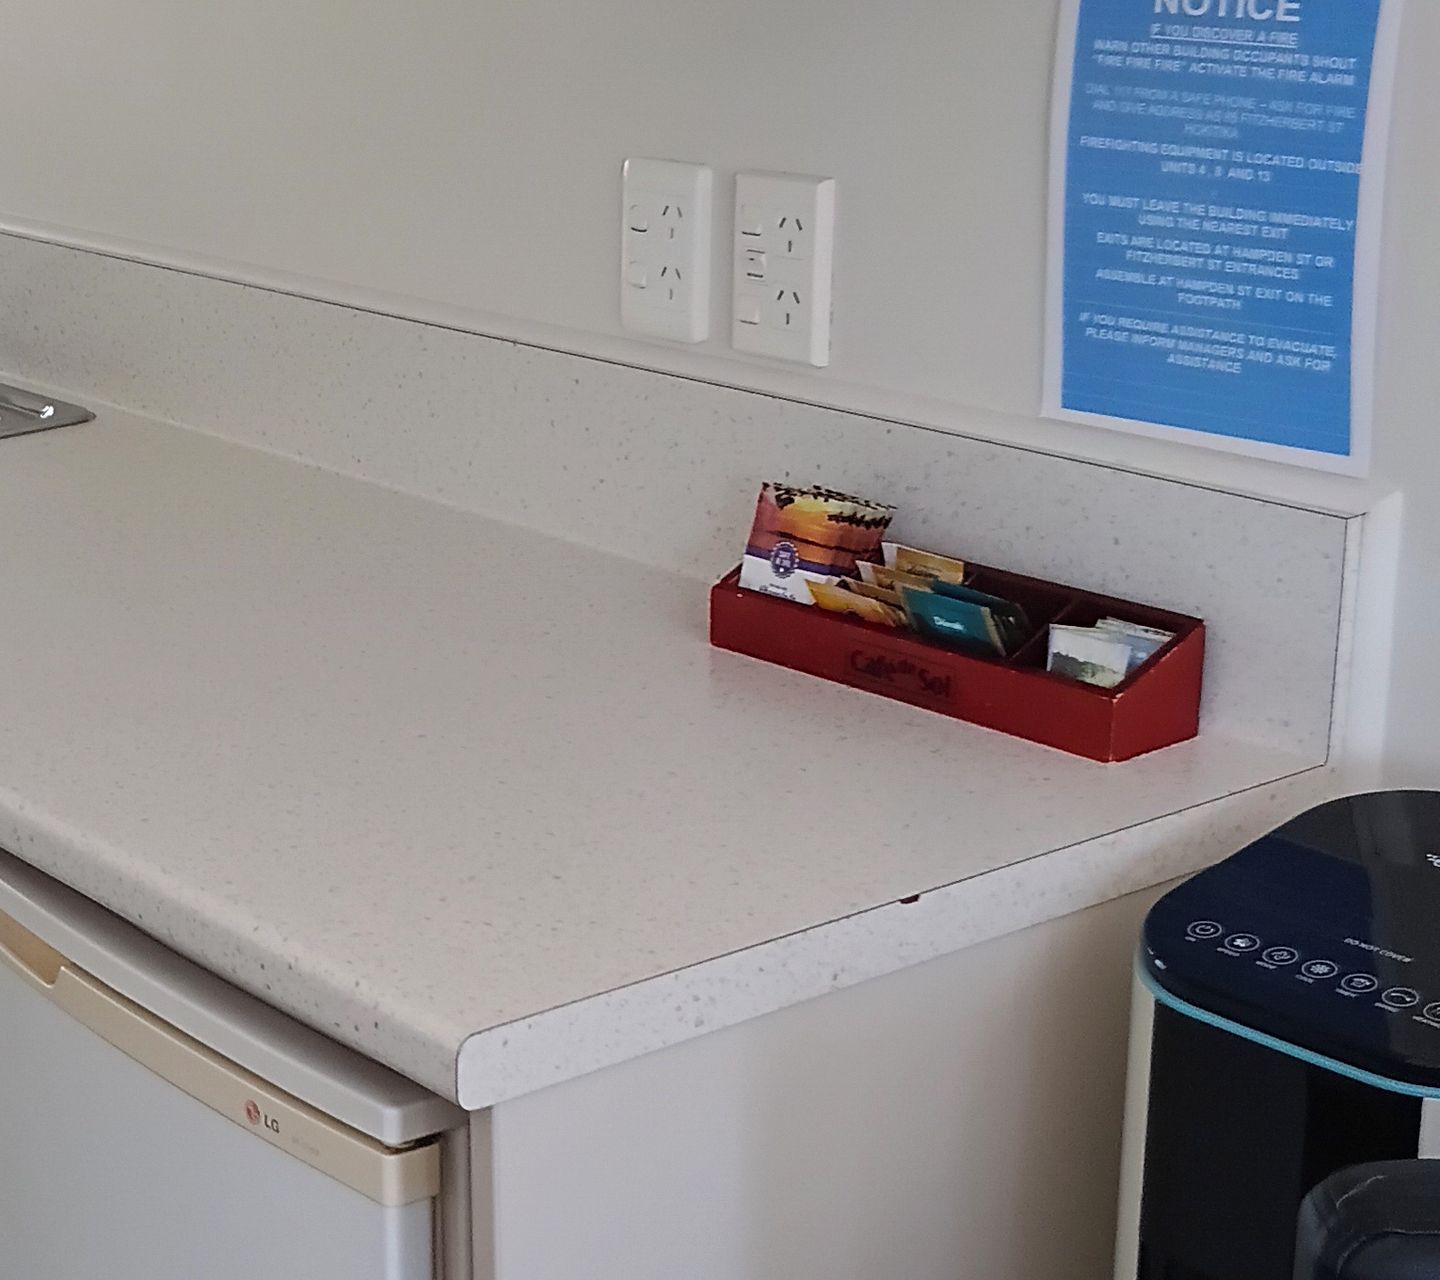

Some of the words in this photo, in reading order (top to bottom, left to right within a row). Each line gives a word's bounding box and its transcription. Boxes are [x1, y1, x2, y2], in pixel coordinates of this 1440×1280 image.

[1165, 24, 1189, 38] YOU
[1192, 26, 1253, 41] DISCOVER
[1269, 31, 1299, 45] FIRE
[1093, 39, 1128, 52] WARN
[1131, 41, 1170, 56] OTHER
[1173, 44, 1230, 60] BUILDING
[1233, 49, 1310, 67] OCCUPANTS
[1312, 55, 1358, 70] SHOUT
[1126, 56, 1152, 69] FIRE
[1189, 61, 1247, 77] ACTIVATE
[1252, 66, 1275, 79] THE
[1277, 69, 1307, 81] FIRE
[1308, 71, 1355, 85] ALARM
[1080, 135, 1159, 154] FIREFIGHTING
[1160, 143, 1229, 160] EQUIPMENT
[1233, 151, 1244, 162] IS
[1247, 153, 1304, 168] LOCATED
[1308, 158, 1363, 174] OUTSIDE
[1227, 167, 1255, 180] AND
[1258, 170, 1273, 181] 13
[1082, 192, 1106, 206] YOU
[1108, 195, 1140, 209] MUST
[1143, 199, 1180, 213] LEAVE
[1183, 202, 1206, 216] THE
[1208, 205, 1267, 222] BUILDING
[1139, 214, 1175, 228] USING
[1177, 218, 1200, 230] THE
[1202, 220, 1258, 236] NEAREST
[1261, 226, 1289, 240] EXIT
[1096, 232, 1129, 245] EXITS
[1130, 236, 1154, 249] ARE
[1156, 239, 1210, 255] LOCATED
[1213, 244, 1230, 256] AT
[1296, 253, 1313, 265] ST
[1315, 255, 1336, 269] OR
[1207, 259, 1222, 271] ST
[1224, 261, 1300, 280] ENTRANCES
[1157, 275, 1175, 287] AT
[1237, 285, 1253, 296] ST
[1255, 287, 1283, 301] EXIT
[1285, 291, 1305, 303] ON
[1307, 293, 1334, 308] THE
[1177, 292, 1243, 310] FOOTPATH
[1093, 314, 1116, 327] YOU
[1118, 317, 1169, 334] REQUIRE
[1170, 324, 1246, 344] ASSISTANCE
[1248, 334, 1265, 347] TO
[1085, 327, 1129, 342] PLEASE
[1131, 333, 1176, 349] INFORM
[1177, 339, 1245, 360] MANAGERS
[1246, 349, 1273, 363] AND
[1276, 354, 1302, 368] ASK
[1304, 357, 1333, 372] FOR
[1167, 353, 1242, 374] ASSISTANCE
[263, 1114, 280, 1134] LG
